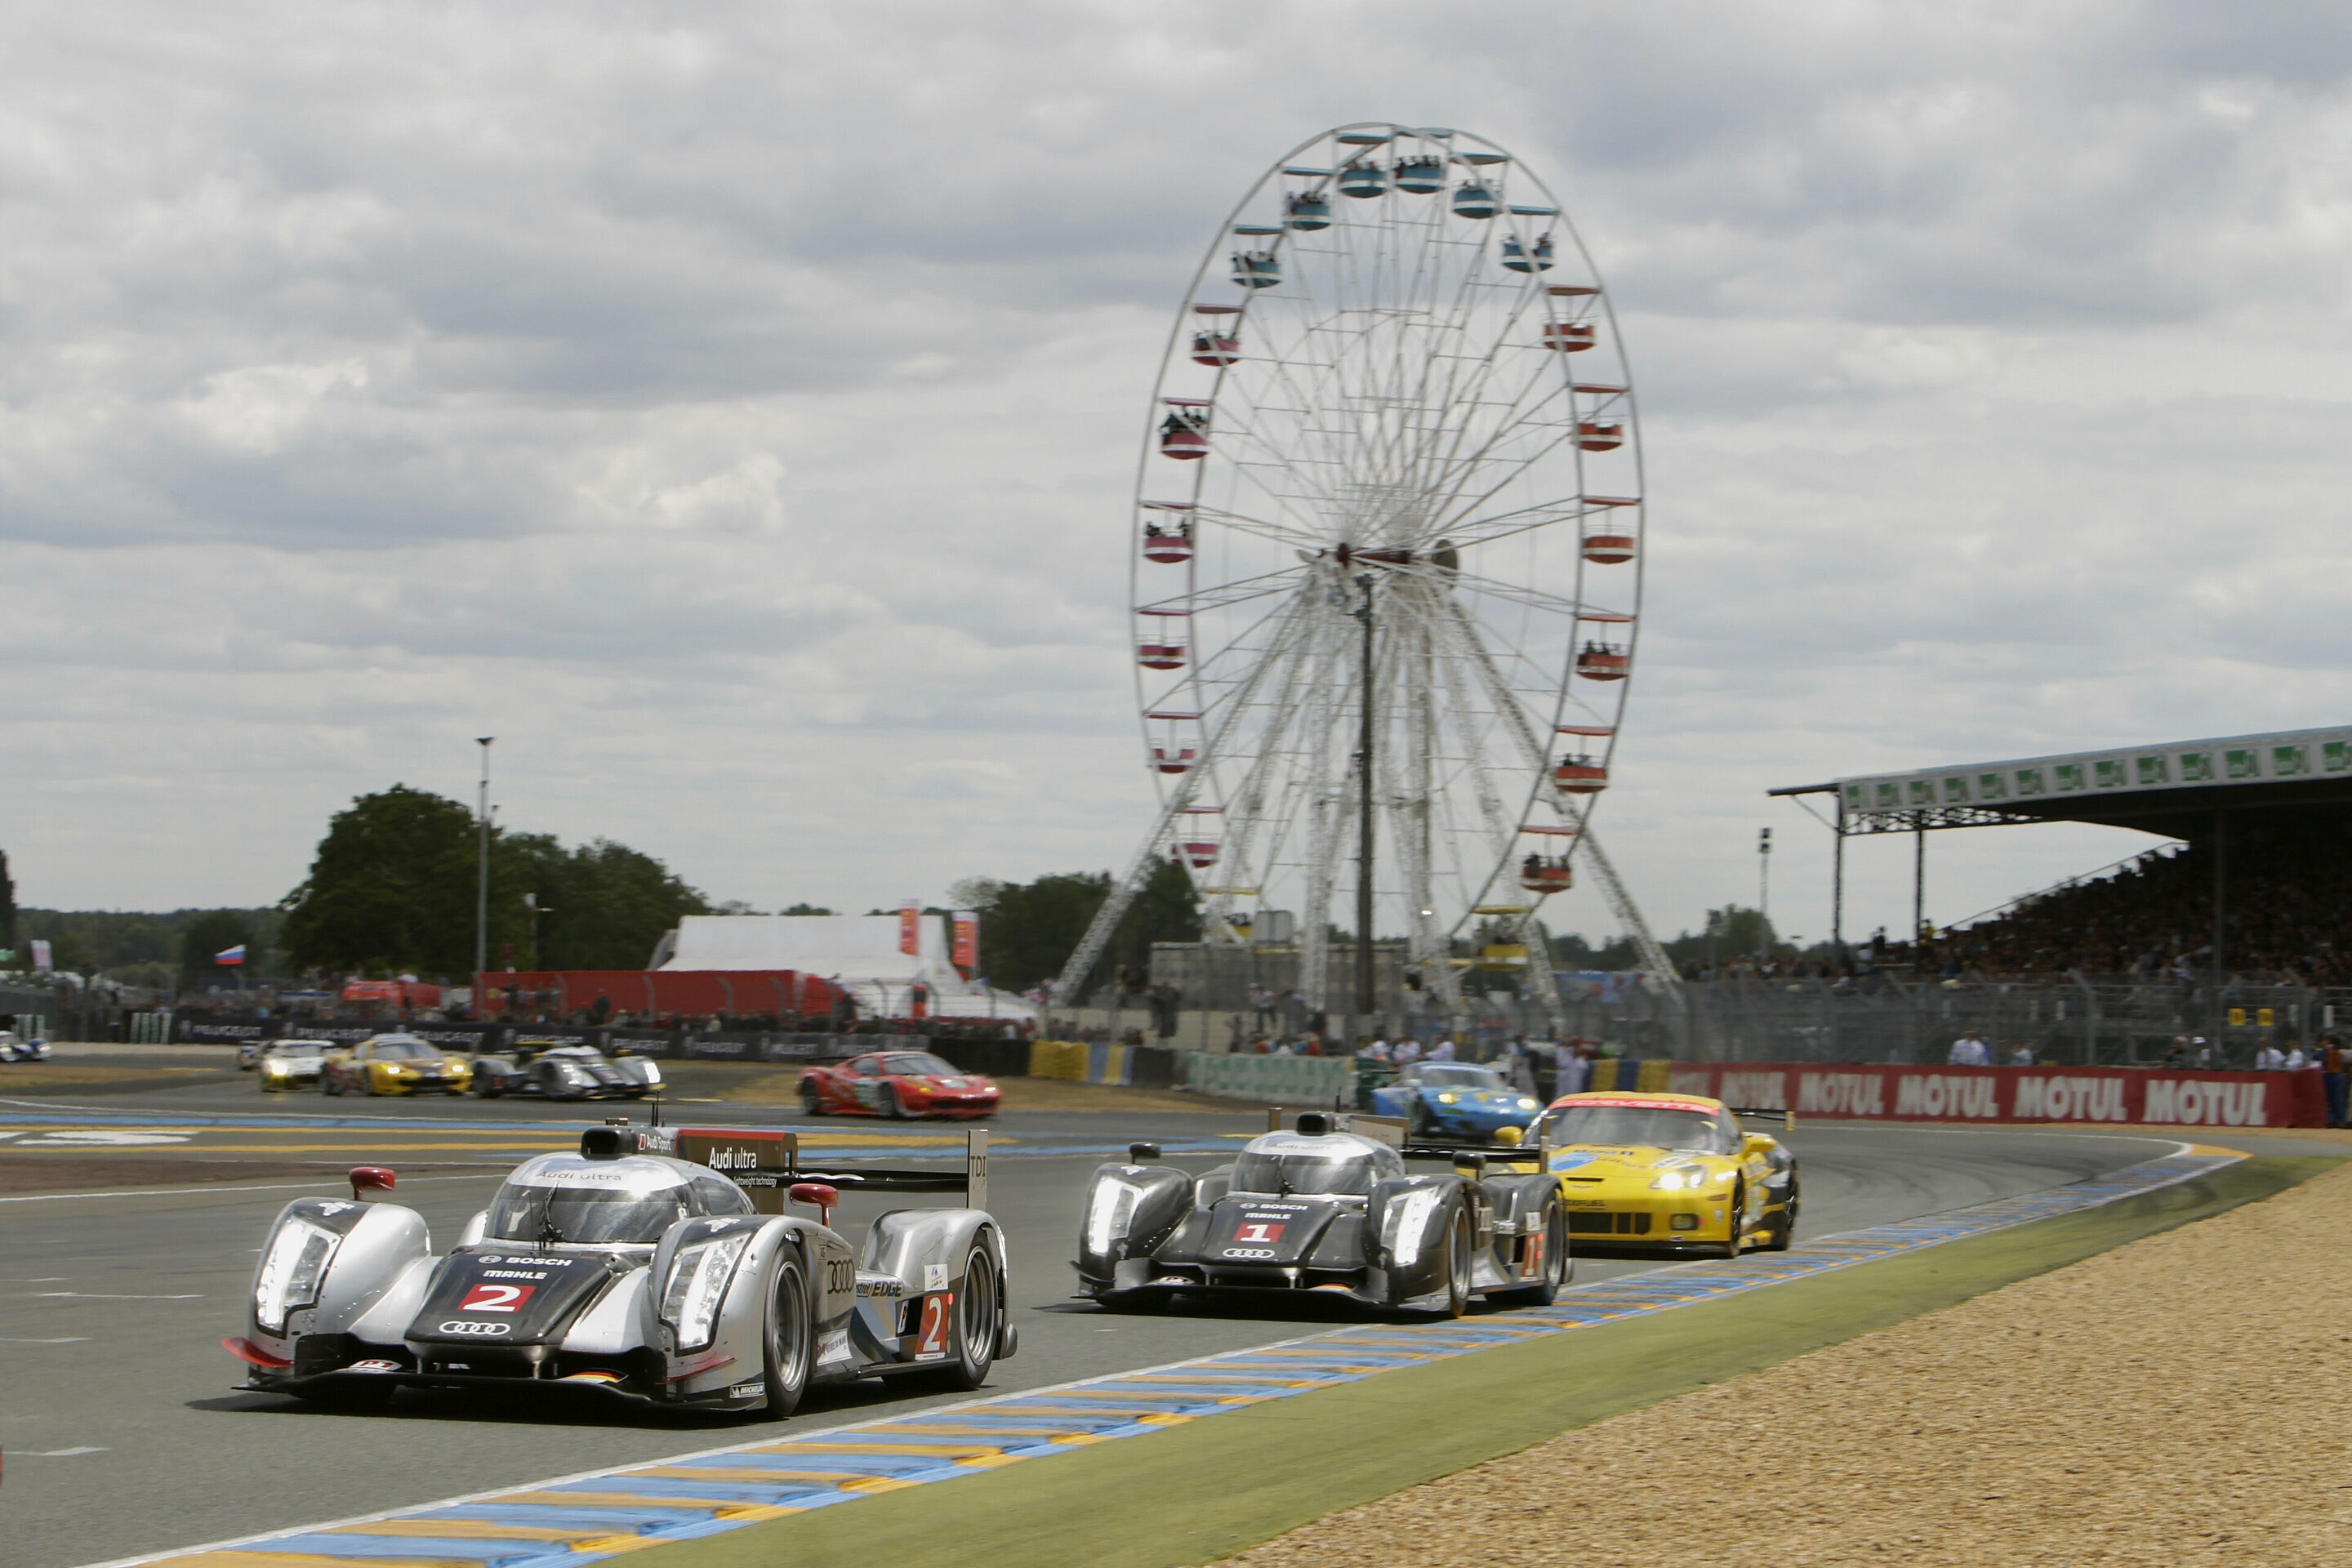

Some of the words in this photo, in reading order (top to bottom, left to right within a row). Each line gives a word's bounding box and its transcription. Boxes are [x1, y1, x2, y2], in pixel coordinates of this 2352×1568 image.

[1798, 1072, 1885, 1115] MOTUL
[1894, 1074, 1998, 1117] MOTUL
[2013, 1076, 2127, 1120] MOTUL
[2142, 1080, 2267, 1125] MOTUL
[646, 1134, 657, 1149] Audi
[658, 1136, 672, 1152] Sport
[709, 1147, 733, 1169] Audi
[734, 1147, 757, 1169] ultra
[971, 1156, 987, 1177] TDI
[536, 1171, 575, 1179] Audi
[1240, 1225, 1271, 1242] 1
[506, 1257, 572, 1267] BOSCH
[1525, 1236, 1535, 1276] 1
[483, 1270, 548, 1280] MAHLE
[461, 1285, 522, 1312] 2
[871, 1281, 902, 1297] EDGE
[923, 1297, 942, 1352] 2
